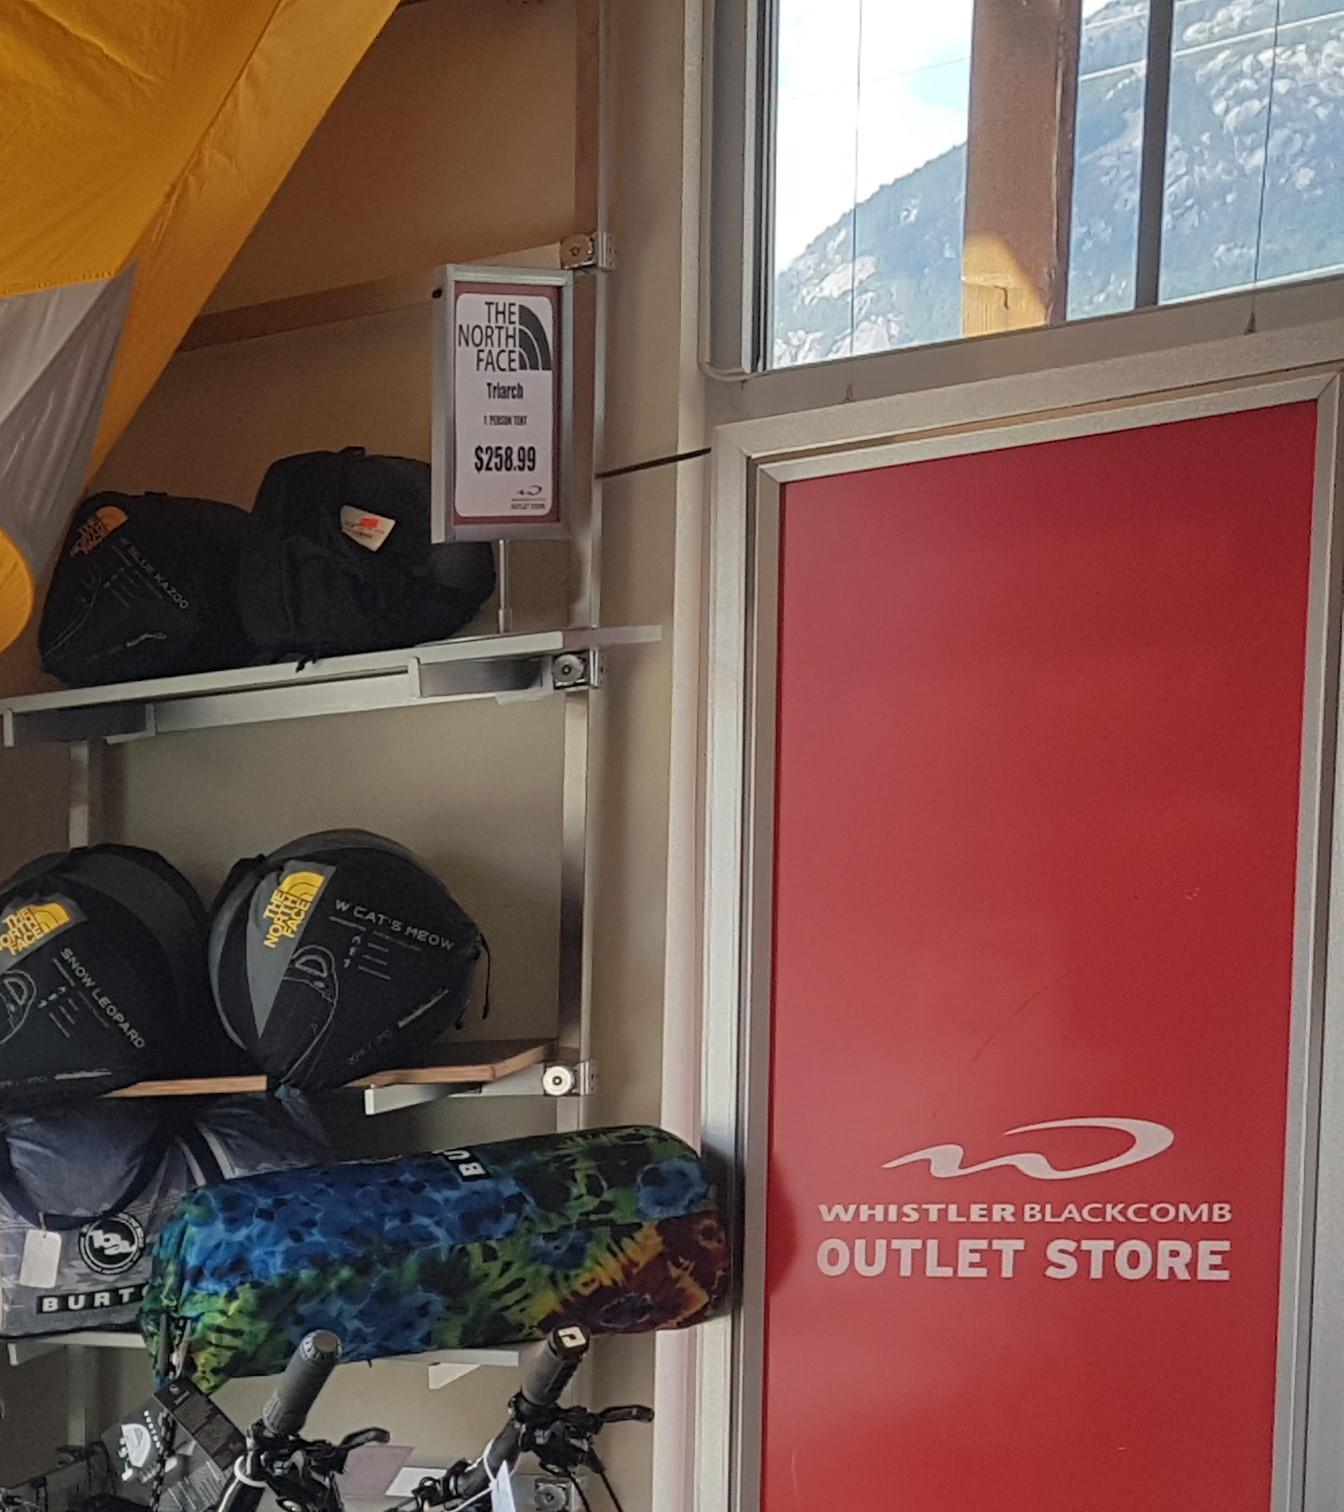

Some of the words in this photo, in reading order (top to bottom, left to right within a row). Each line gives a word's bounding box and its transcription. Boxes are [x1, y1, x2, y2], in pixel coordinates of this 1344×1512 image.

[485, 302, 516, 325] THE
[458, 325, 516, 348] NORTH
[476, 350, 517, 372] FACE
[486, 382, 523, 400] Triarch
[474, 446, 537, 474] $258.99
[2, 906, 32, 926] THE
[263, 890, 286, 920] THE
[283, 898, 311, 938] FACE
[264, 894, 300, 949] NORTH
[353, 906, 402, 932] CAT'S
[405, 926, 455, 951] MEOW
[8, 927, 44, 956] FACE
[61, 948, 96, 988] SNOW
[92, 988, 146, 1050] LEOPARD
[817, 1204, 1016, 1223] WHISTLER
[1023, 1203, 1233, 1223] BLACKCOMB
[816, 1238, 1025, 1279] OUTLET
[1044, 1239, 1232, 1281] STORE
[42, 1287, 148, 1313] BURT
